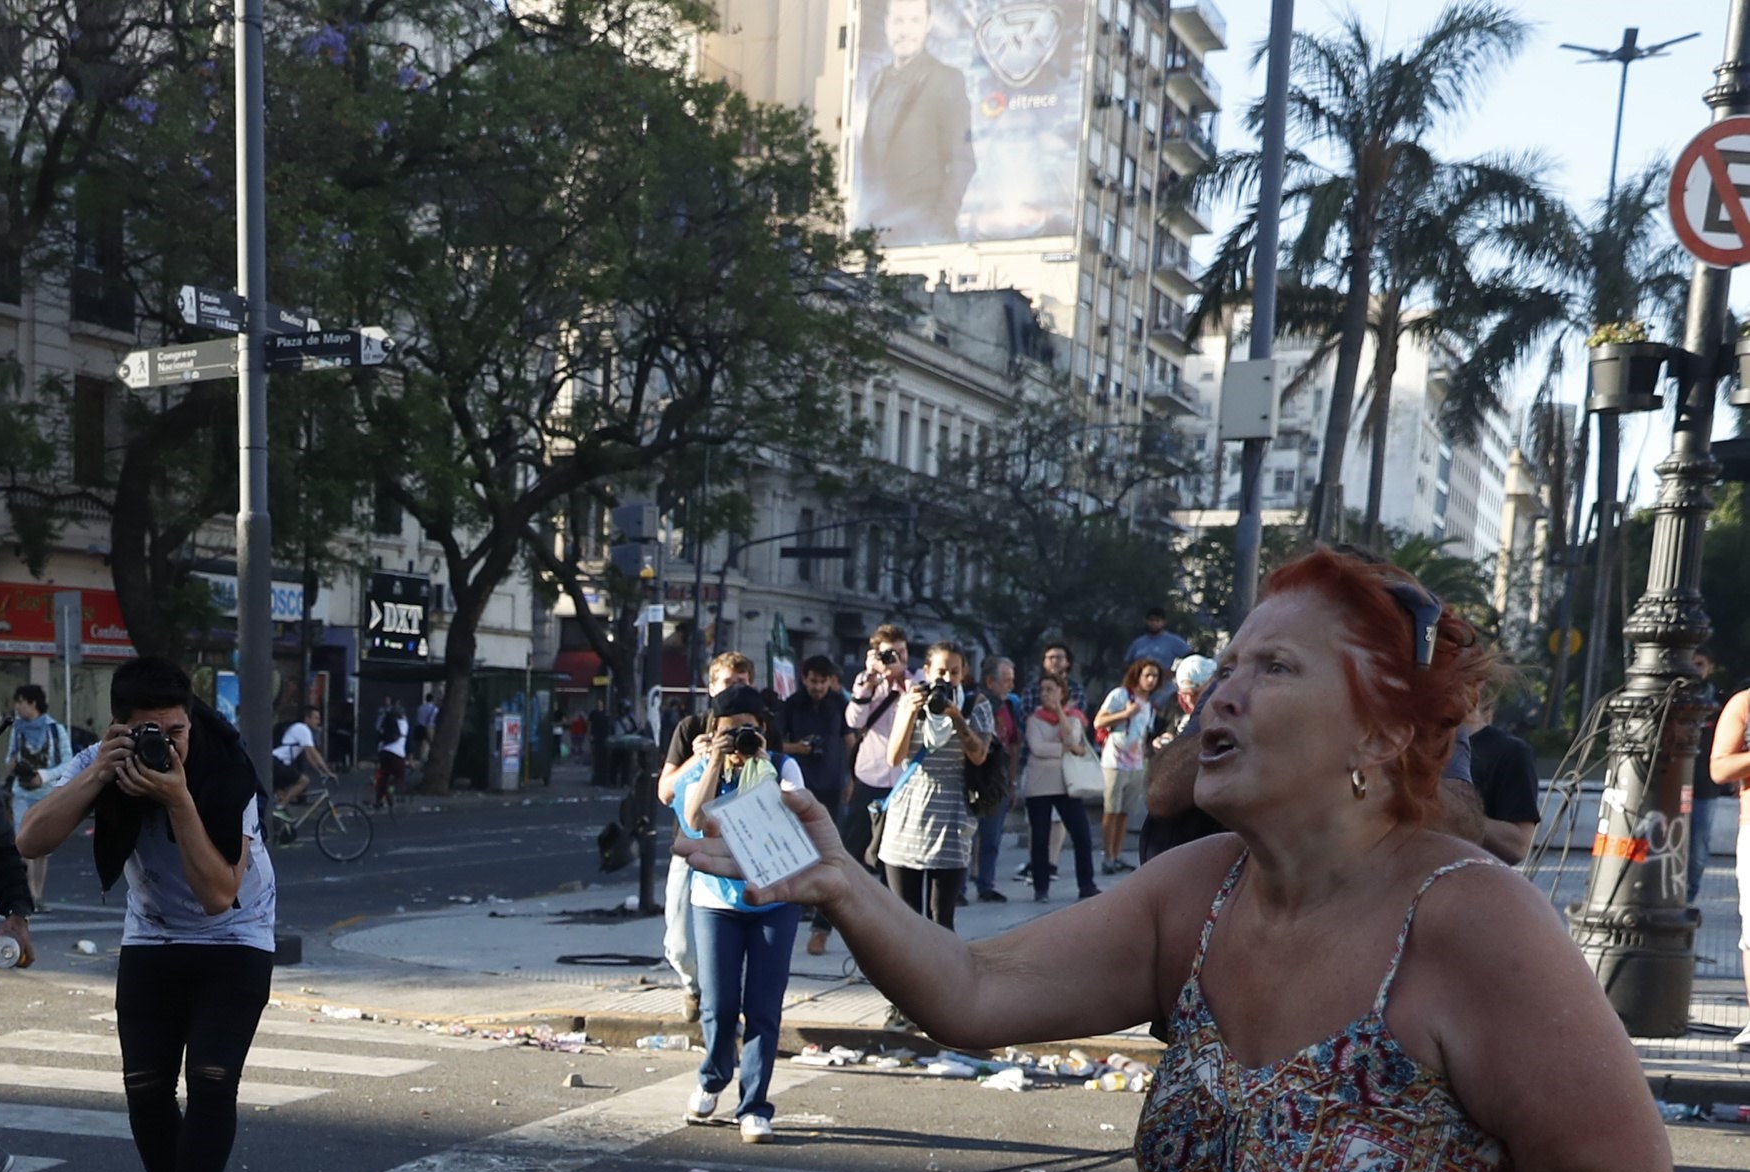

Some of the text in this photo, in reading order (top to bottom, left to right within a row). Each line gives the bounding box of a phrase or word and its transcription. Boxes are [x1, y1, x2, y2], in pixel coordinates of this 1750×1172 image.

[276, 333, 351, 348] Plaza de Mayo
[157, 349, 197, 363] Congreso
[158, 359, 194, 372] Nacional
[382, 601, 424, 635] DXT
